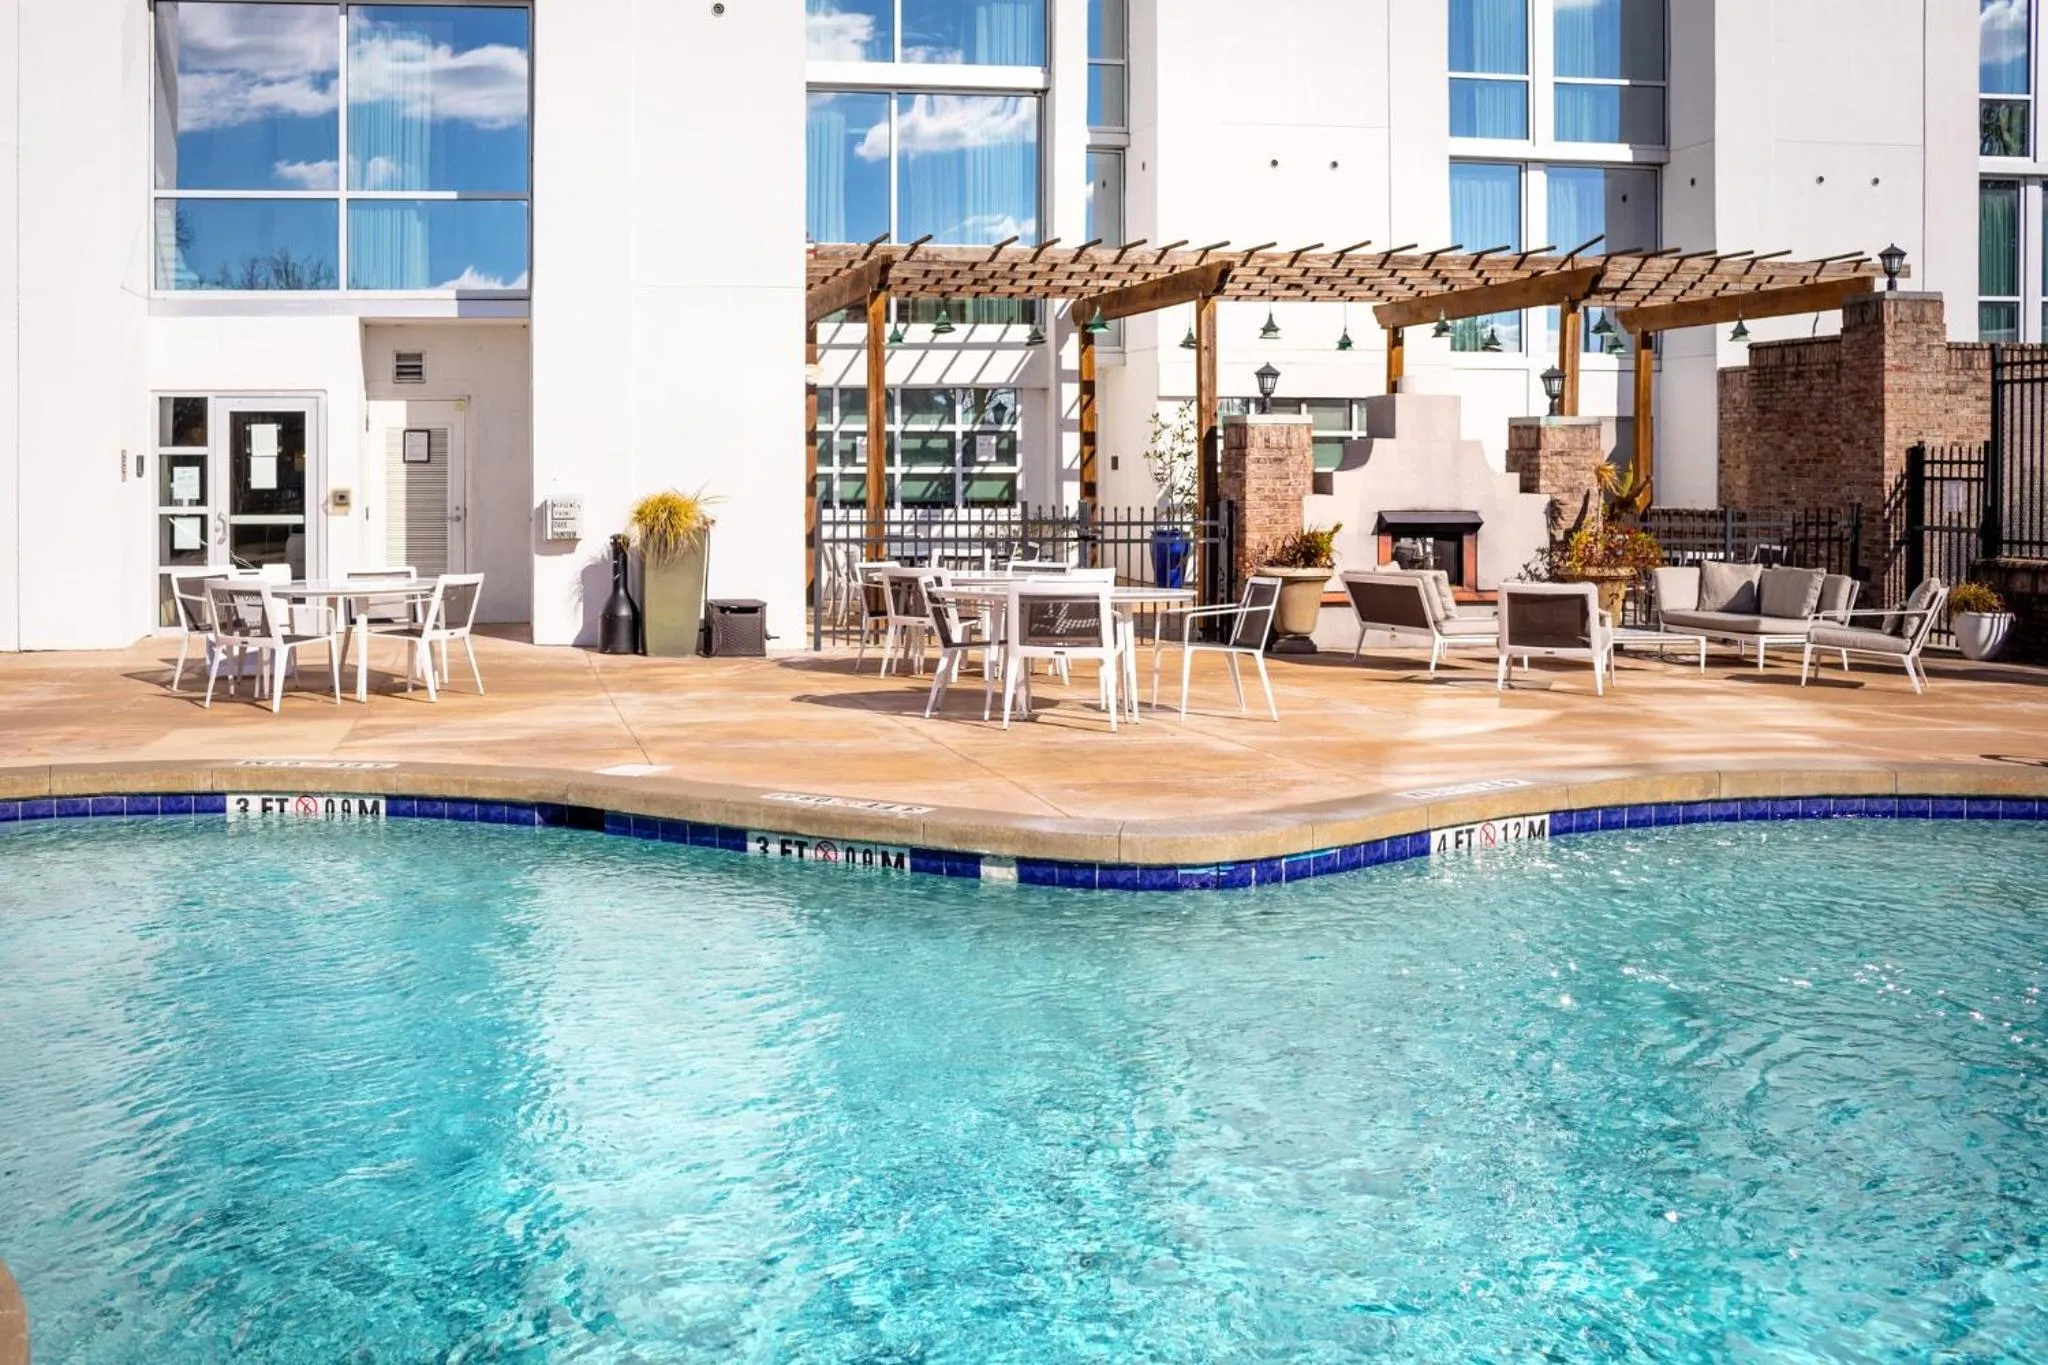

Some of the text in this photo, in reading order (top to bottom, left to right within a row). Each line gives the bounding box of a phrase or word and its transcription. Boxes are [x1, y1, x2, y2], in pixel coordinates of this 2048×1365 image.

[261, 797, 289, 813] FT
[780, 838, 808, 858] FT
[1455, 828, 1475, 849] FT
